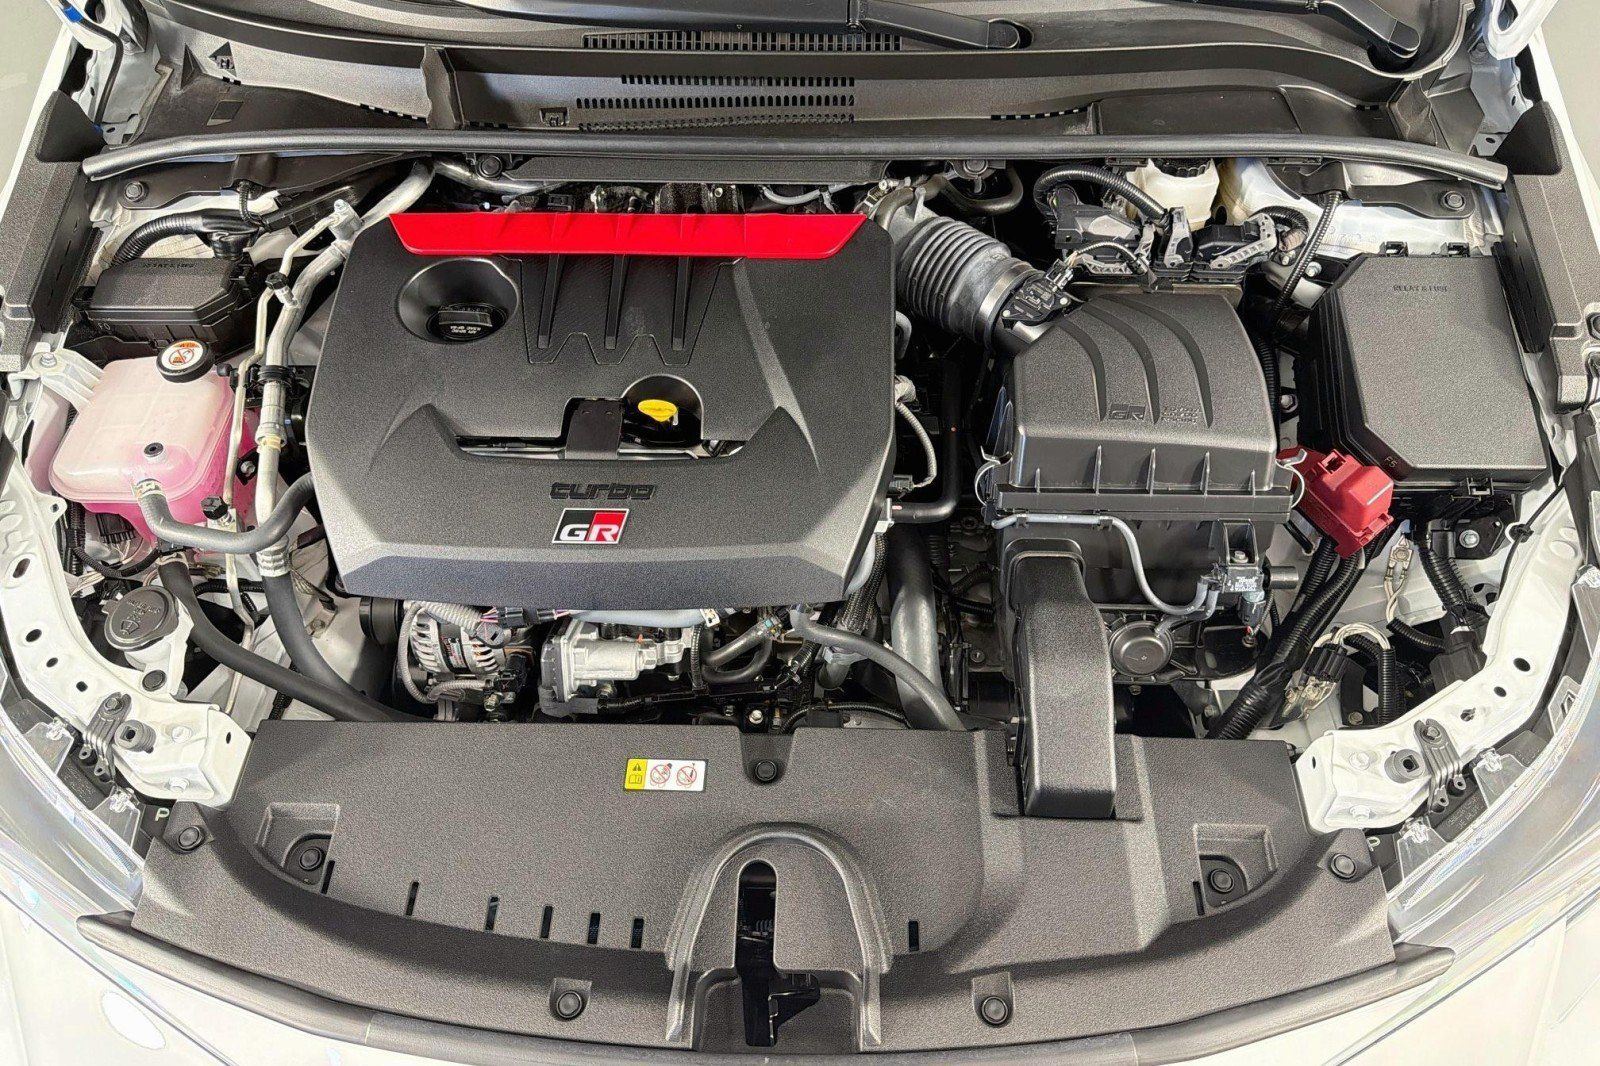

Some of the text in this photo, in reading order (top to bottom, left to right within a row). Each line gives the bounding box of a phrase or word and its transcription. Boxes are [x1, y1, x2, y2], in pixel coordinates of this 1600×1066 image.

[549, 482, 656, 500] turbo
[559, 523, 620, 542] GR
[154, 806, 170, 822] P
